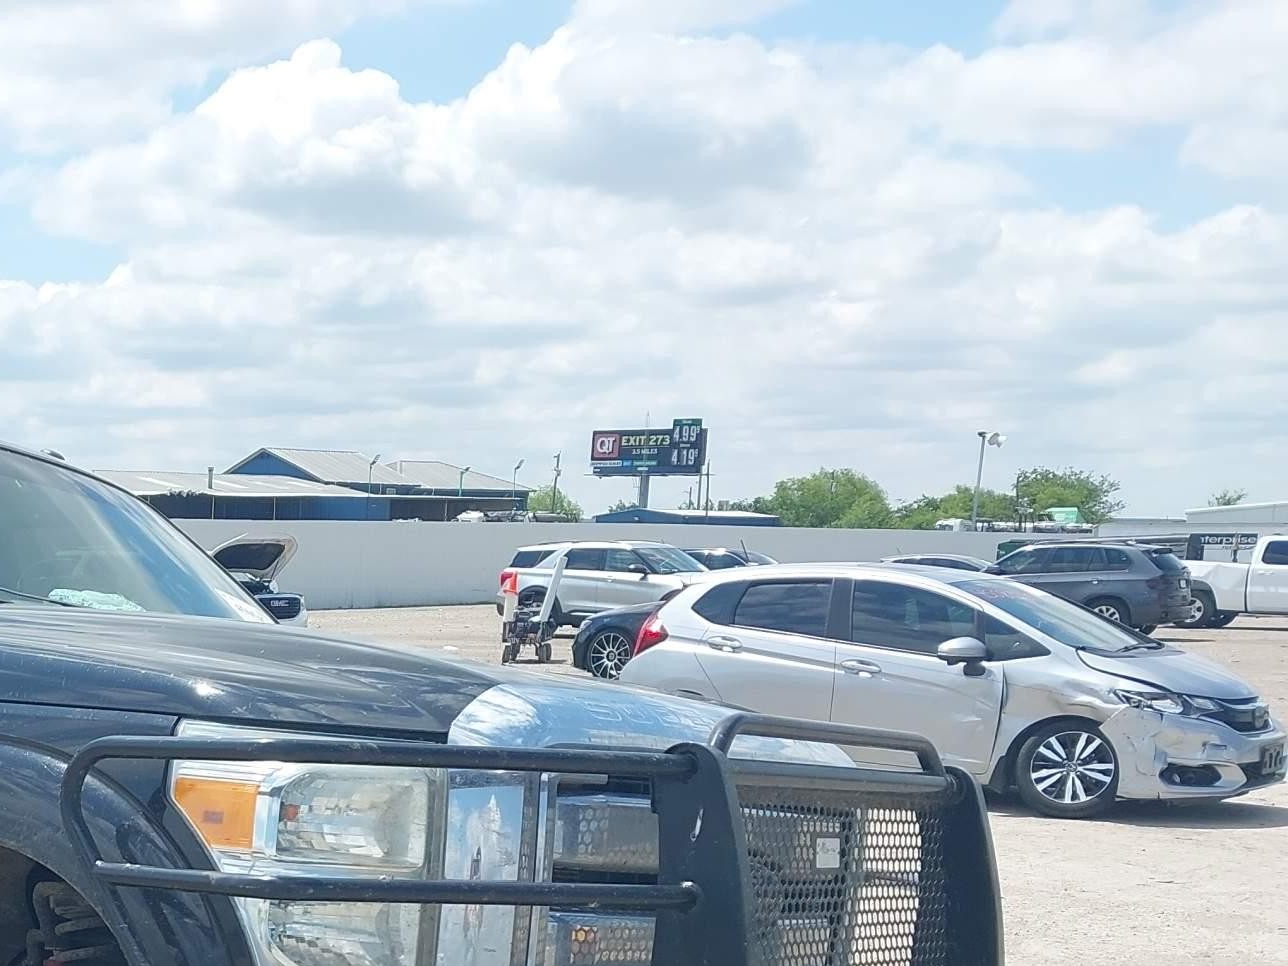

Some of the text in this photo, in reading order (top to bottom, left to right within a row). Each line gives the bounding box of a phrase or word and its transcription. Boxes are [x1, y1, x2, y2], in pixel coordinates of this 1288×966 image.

[596, 436, 616, 454] QT
[621, 435, 670, 446] EXIT 273
